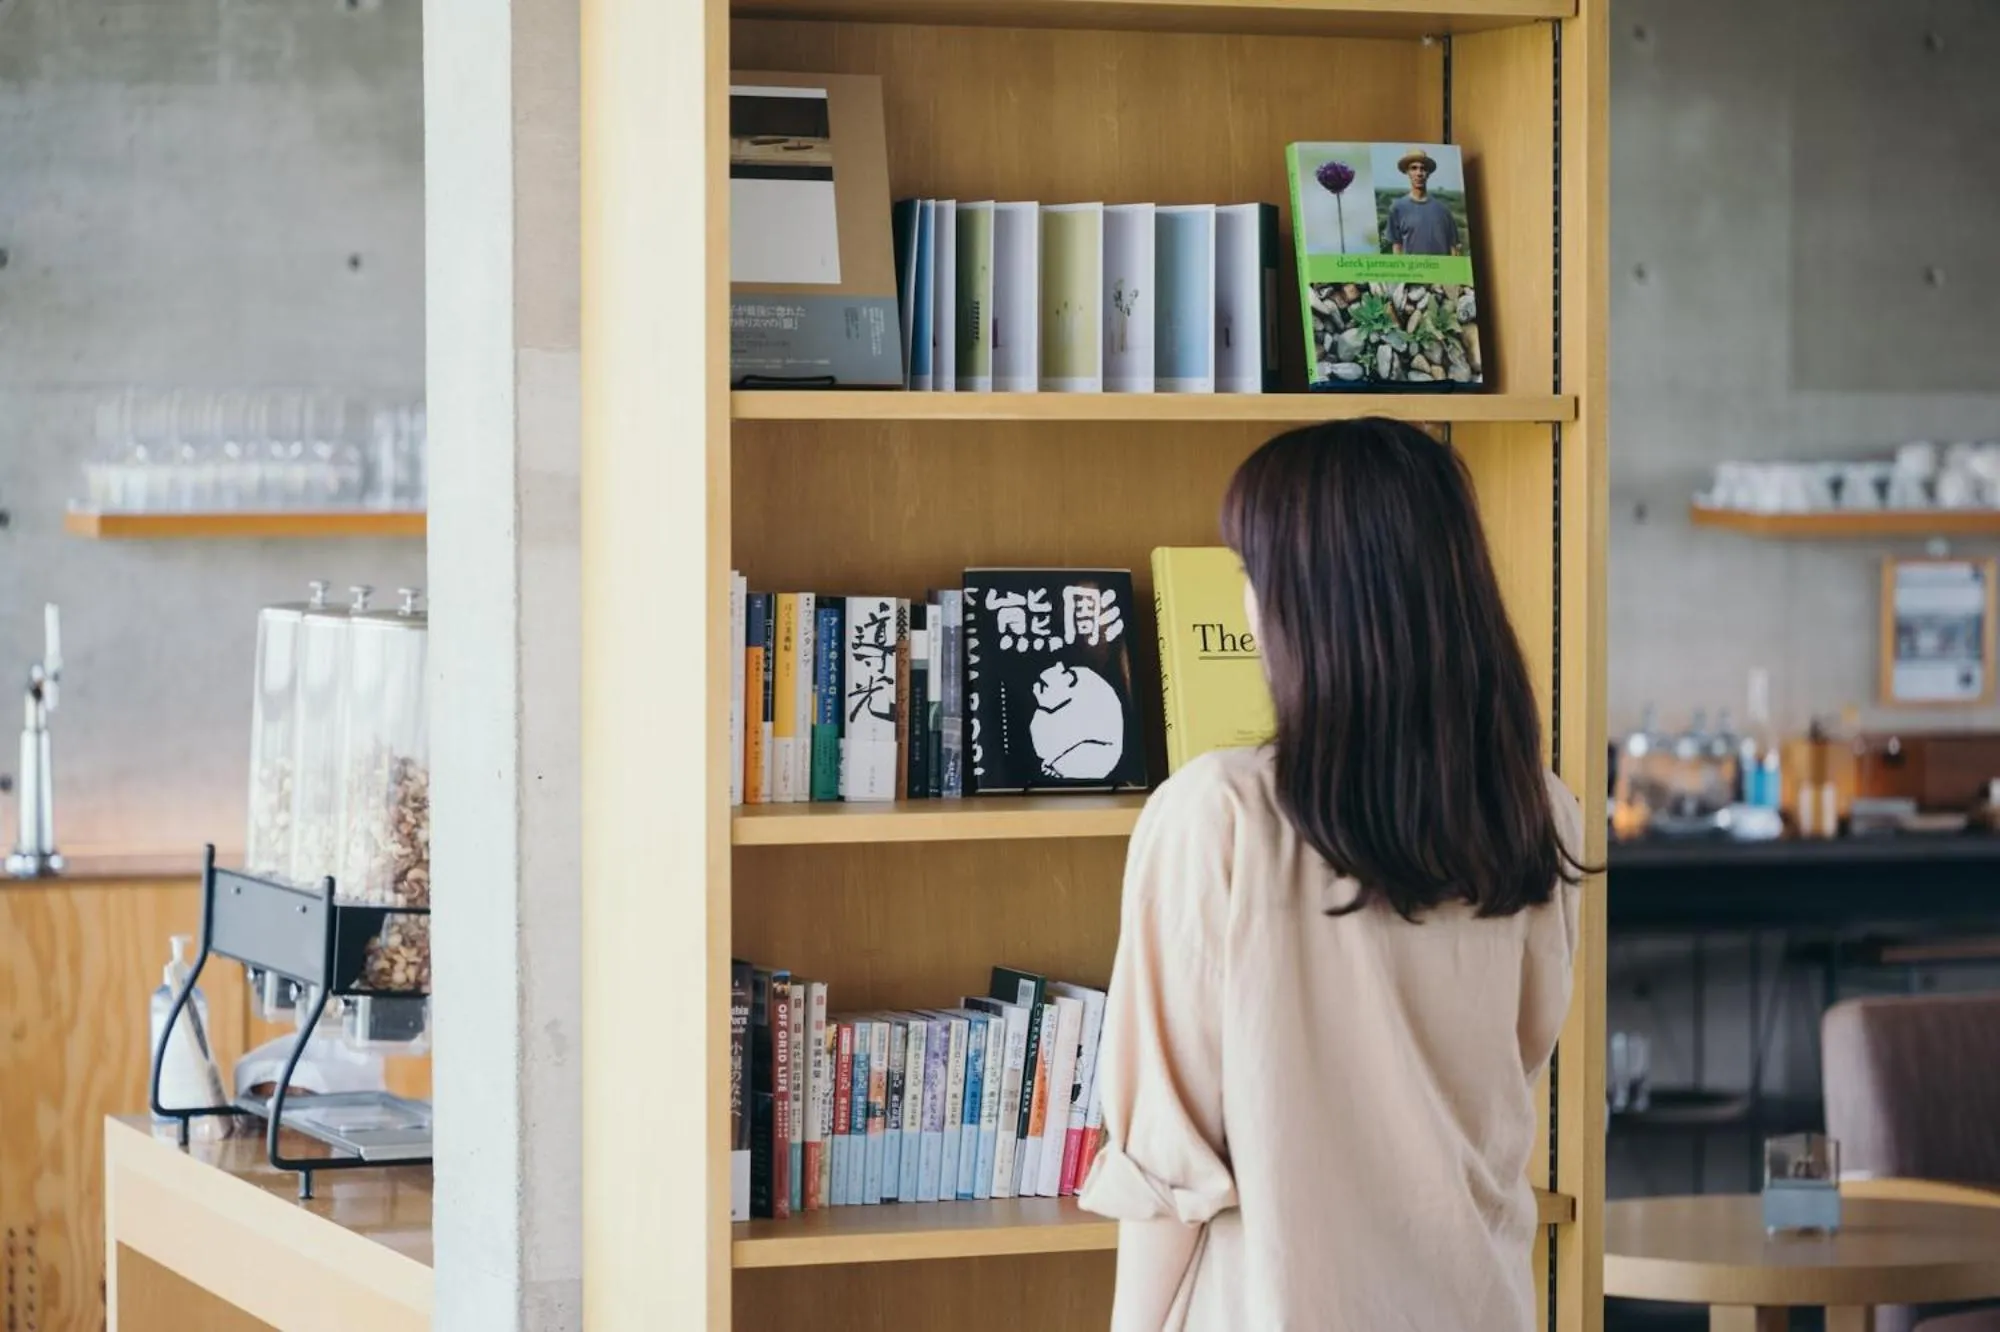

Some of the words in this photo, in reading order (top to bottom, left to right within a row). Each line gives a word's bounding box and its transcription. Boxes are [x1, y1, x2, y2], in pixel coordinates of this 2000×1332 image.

[1337, 256, 1363, 268] derek
[985, 585, 1124, 652] 熊彫
[1192, 623, 1257, 652] The
[829, 617, 838, 695] アートの入り口
[777, 1003, 788, 1031] OFF
[777, 1032, 788, 1063] GRID
[777, 1065, 788, 1093] LIFE
